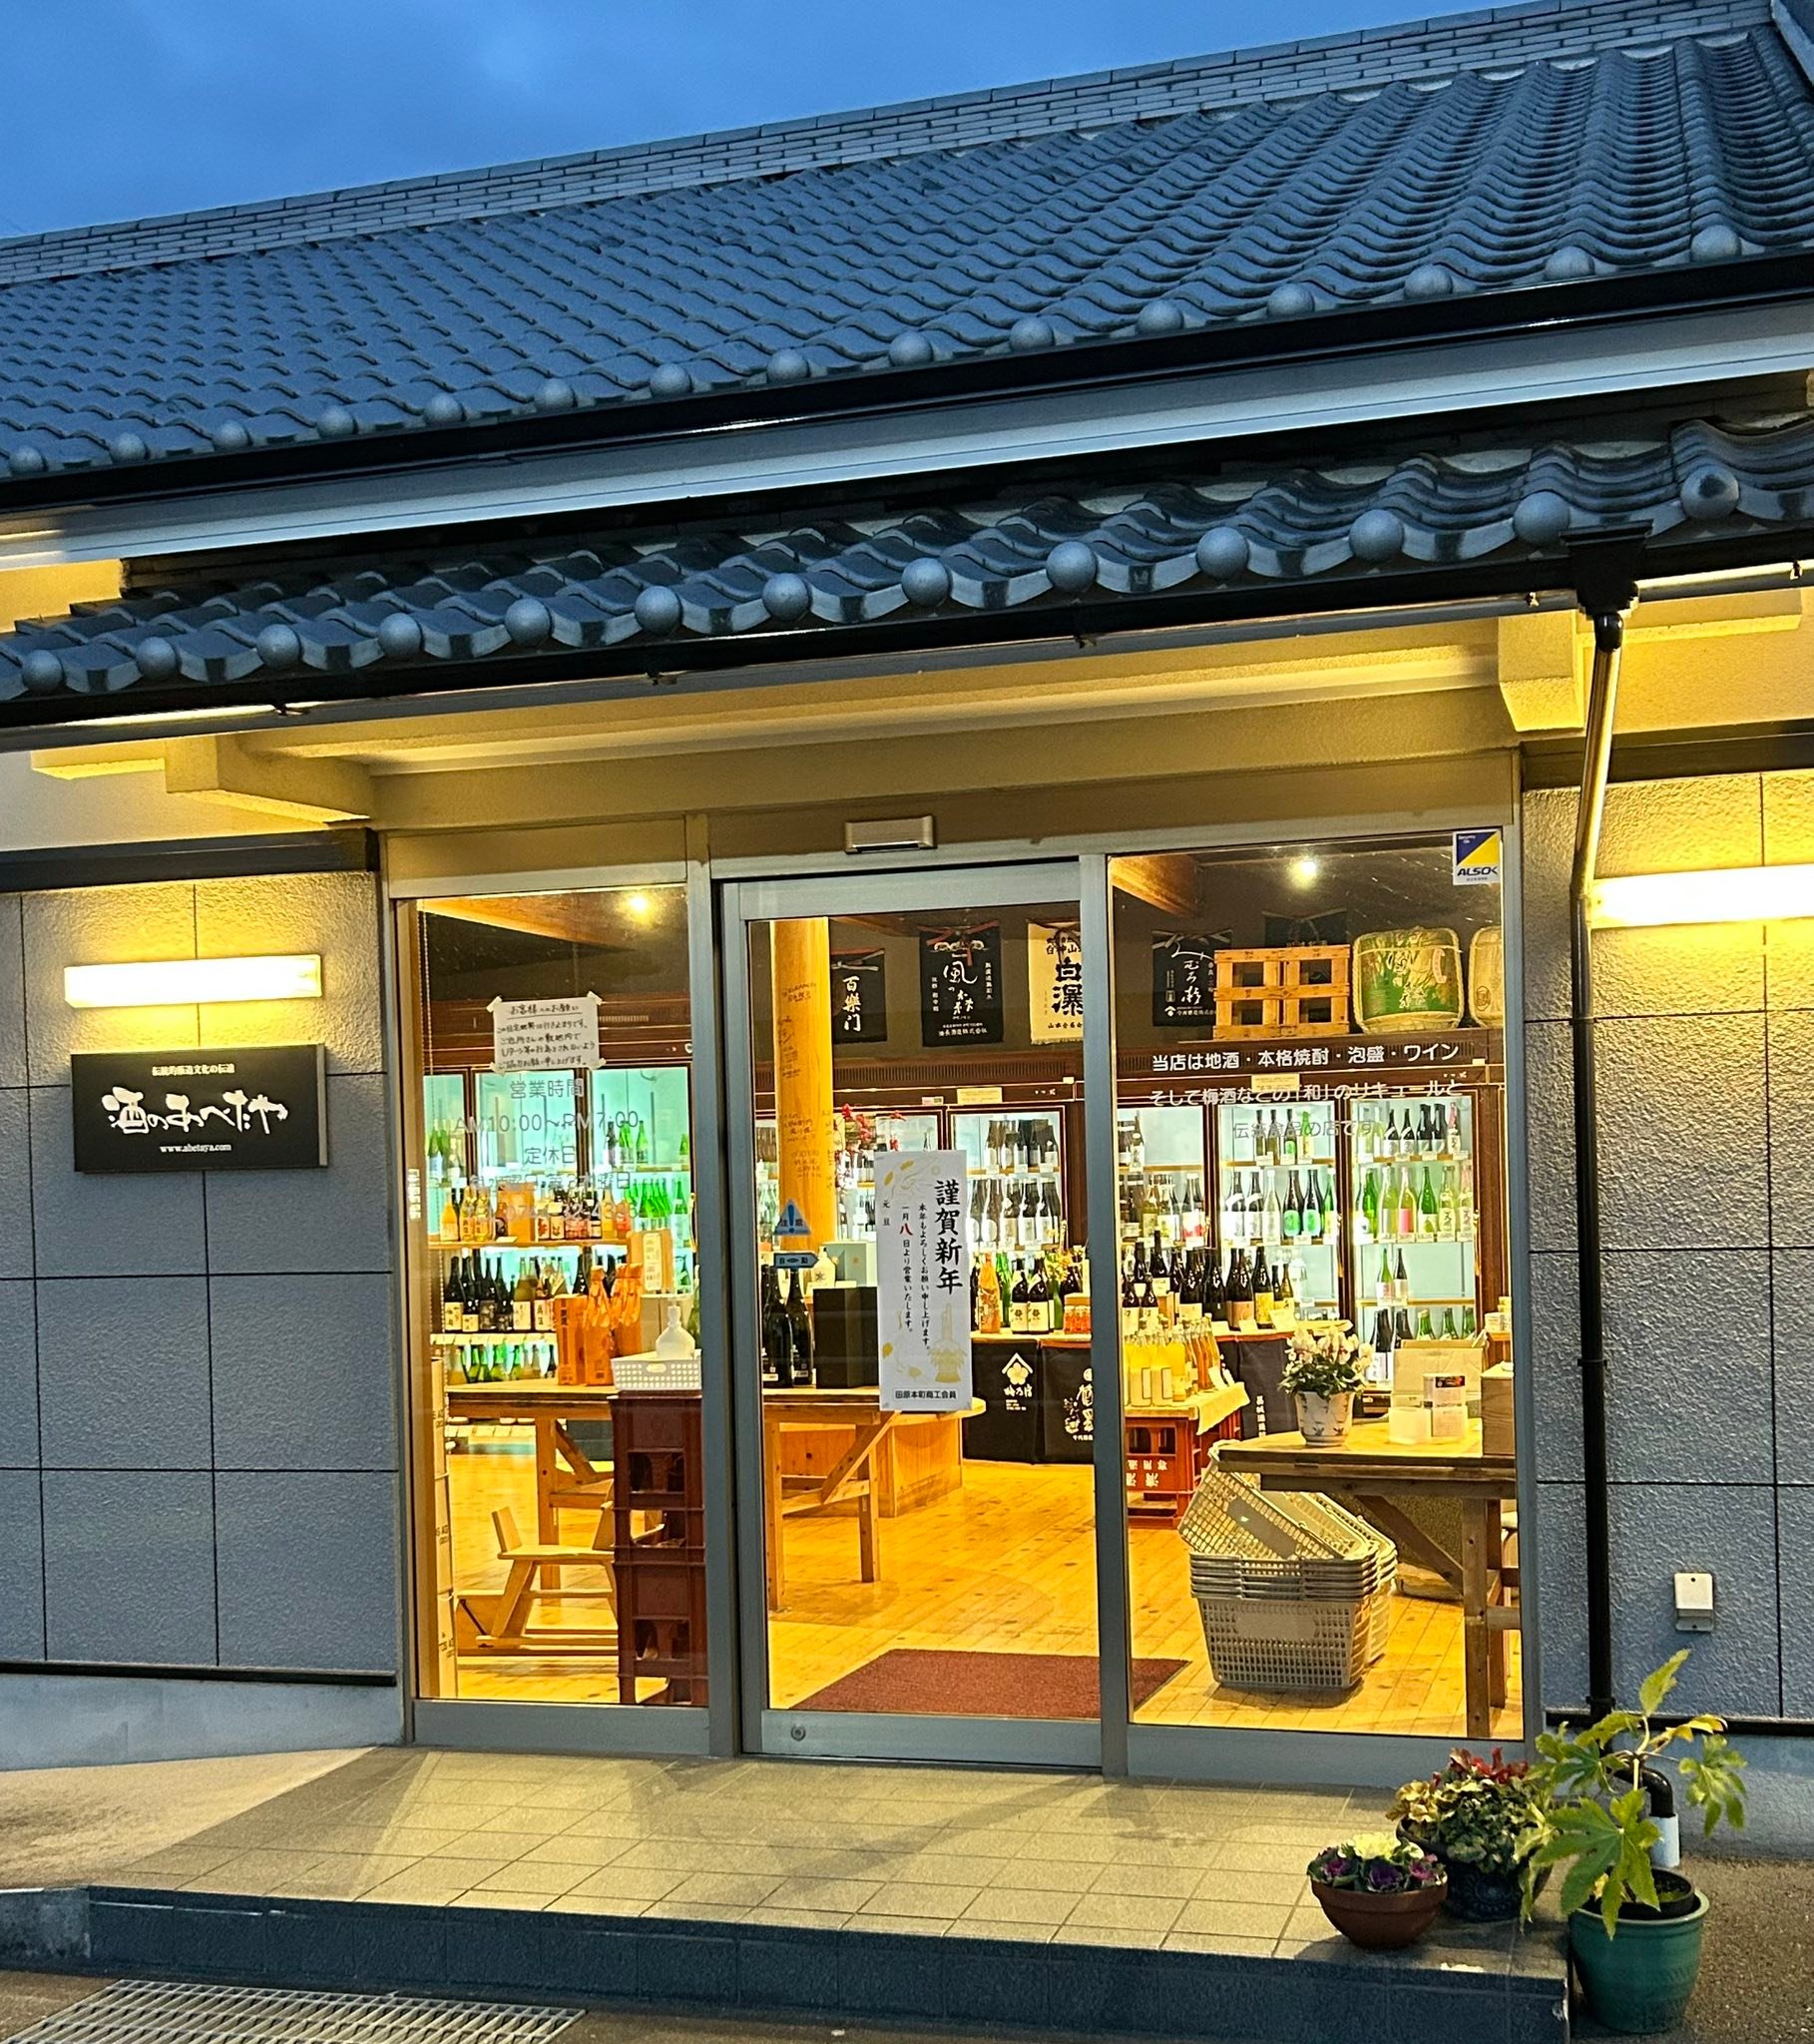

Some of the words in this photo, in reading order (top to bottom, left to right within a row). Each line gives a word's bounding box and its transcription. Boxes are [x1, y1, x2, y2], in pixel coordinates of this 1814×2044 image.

[1458, 866, 1498, 876] ALSOK
[943, 961, 978, 1015] 風の森
[510, 1078, 585, 1099] 営業時間
[524, 1146, 576, 1166] 定休日
[882, 1200, 891, 1227] 元旦
[934, 1179, 963, 1295] 謹賀新年
[899, 1206, 914, 1332] 一月八日より営業いたします。
[918, 1203, 930, 1350] 本年もよろしくお願い申し上げます。
[895, 1390, 957, 1399] 田原本町商工会員
